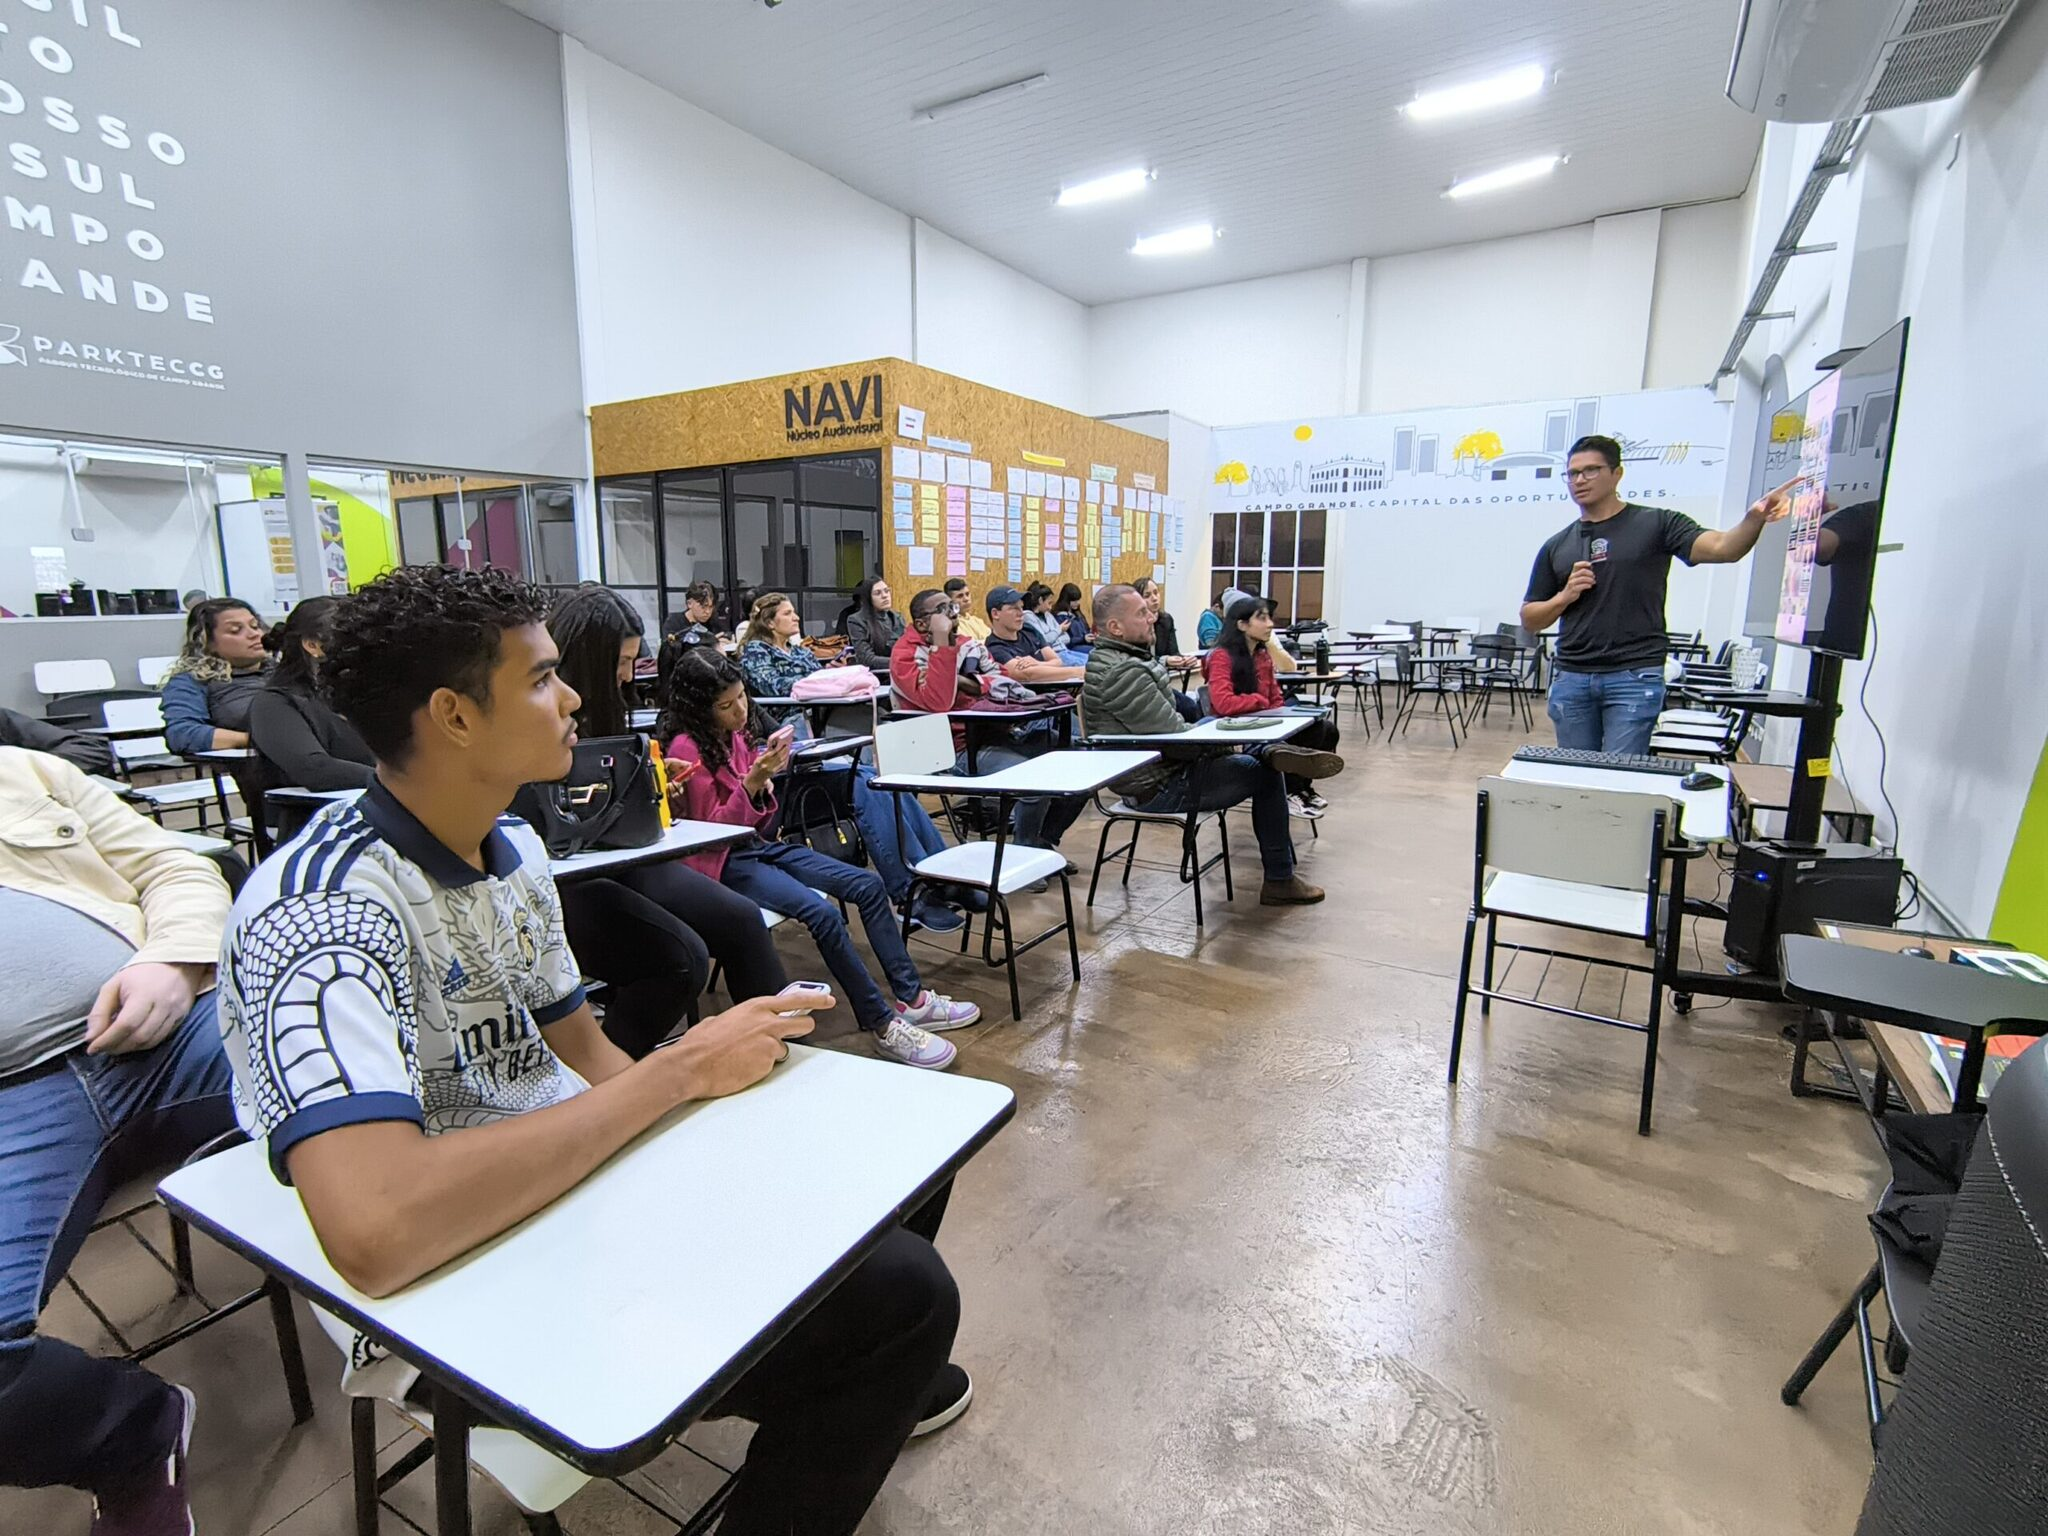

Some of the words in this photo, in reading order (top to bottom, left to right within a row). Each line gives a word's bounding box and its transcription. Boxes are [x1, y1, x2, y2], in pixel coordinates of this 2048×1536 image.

[0, 22, 73, 74] O
[22, 0, 142, 48] IL
[8, 142, 155, 210] SUL
[4, 195, 165, 261] MPO
[33, 335, 225, 380] PARKTECCG
[784, 374, 882, 429] NAVI
[822, 420, 883, 438] Audiovisual
[1245, 502, 1293, 511] CAMPO
[1368, 498, 1441, 508] CAPITAL
[1449, 496, 1482, 505] DAS
[1490, 488, 1676, 504] OPORTUDES.
